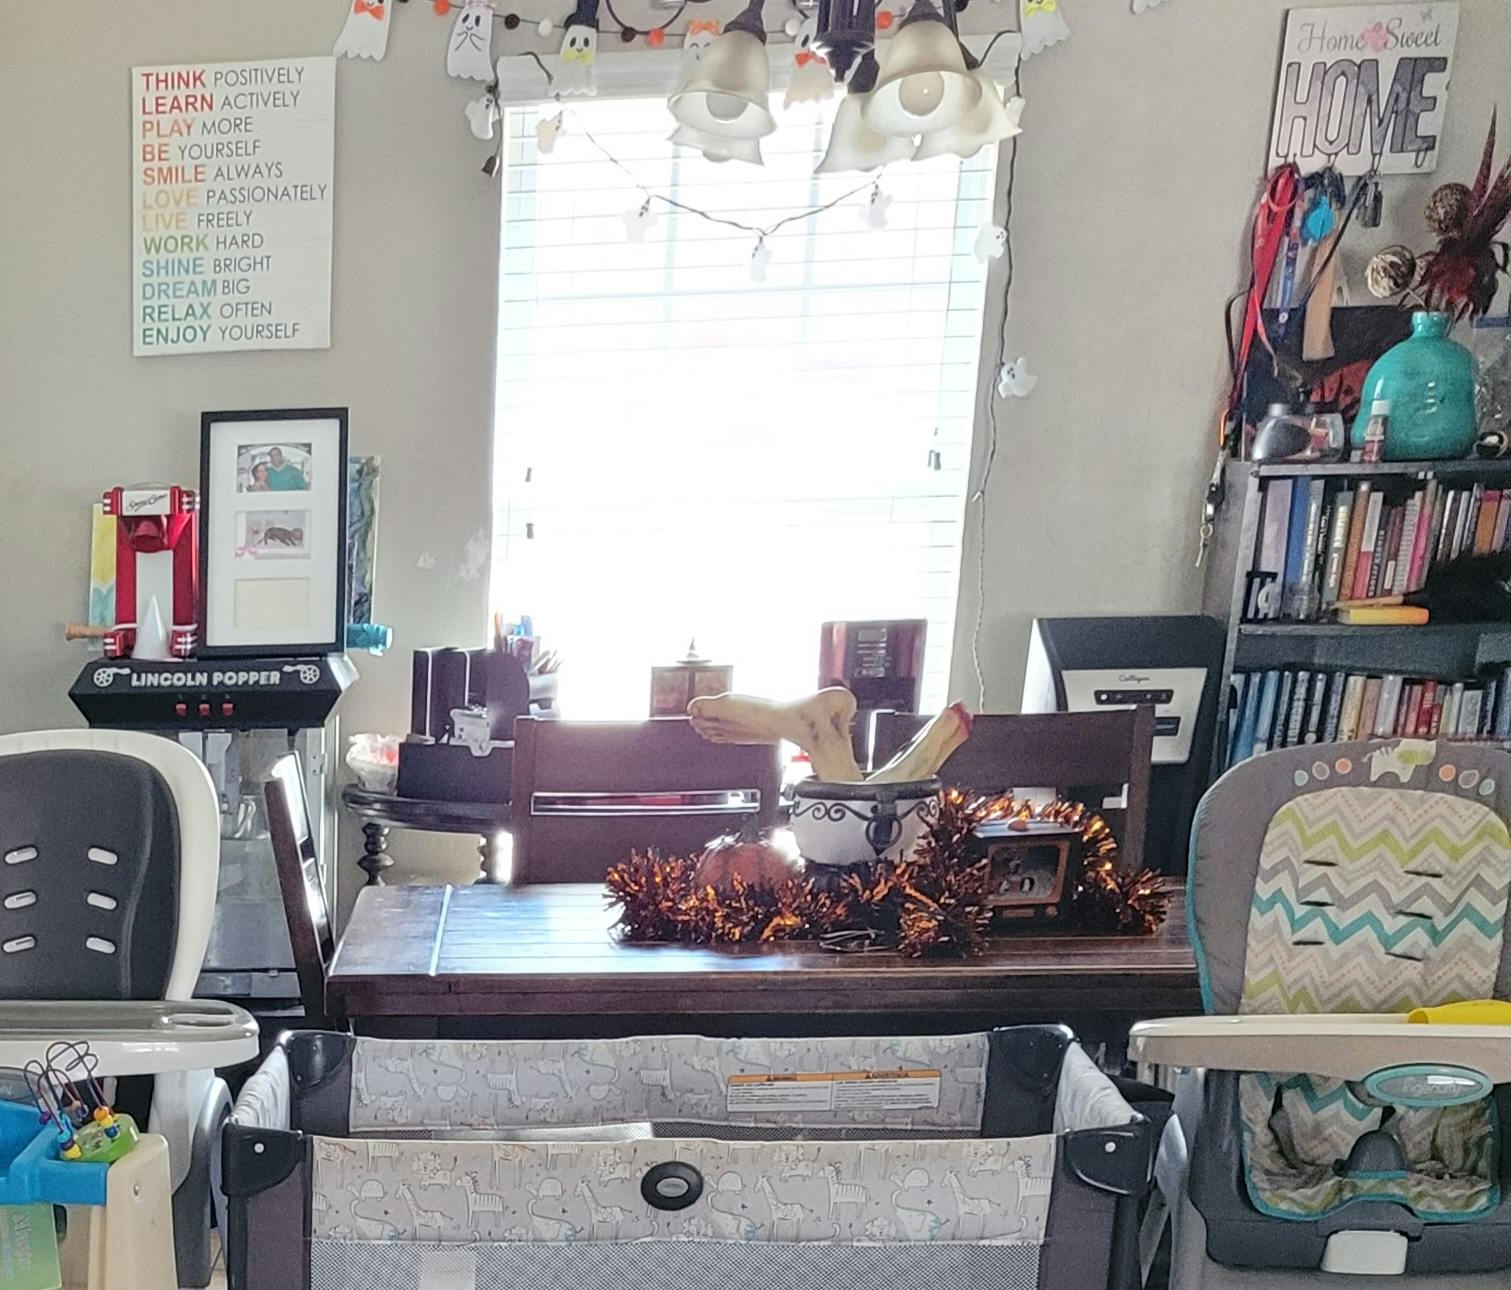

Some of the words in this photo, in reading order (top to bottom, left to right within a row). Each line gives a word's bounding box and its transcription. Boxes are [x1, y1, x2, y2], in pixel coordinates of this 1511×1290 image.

[1297, 23, 1365, 53] Home
[1384, 17, 1441, 50] Sweet
[141, 69, 207, 92] THINK
[214, 66, 305, 88] POSITIVELY
[141, 93, 214, 115] LEARN
[220, 91, 300, 111] ACTIVELY
[1276, 57, 1448, 157] HOME
[141, 118, 195, 139] PLAY
[201, 117, 253, 136] MORE
[142, 143, 170, 163] BE
[177, 140, 261, 161] YOURSELF
[142, 164, 207, 186] SMILE
[213, 162, 284, 182] ALWAYS
[142, 188, 198, 210] LOVE
[206, 184, 327, 206] PASSIONATELY
[142, 211, 187, 233] LIVE
[197, 210, 253, 230] FREELY
[143, 233, 209, 255] WORK
[216, 233, 264, 250] HARD
[142, 256, 204, 278] SHINE
[213, 255, 272, 274] BRIGHT
[142, 279, 217, 301] DREAM
[222, 278, 250, 296] BIG
[142, 302, 212, 323] RELAX
[219, 301, 272, 319] OFTEN
[142, 324, 212, 346] ENJOY
[219, 323, 300, 341] YOURSELF
[130, 670, 209, 687] LINCOLN
[212, 670, 281, 686] POPPER
